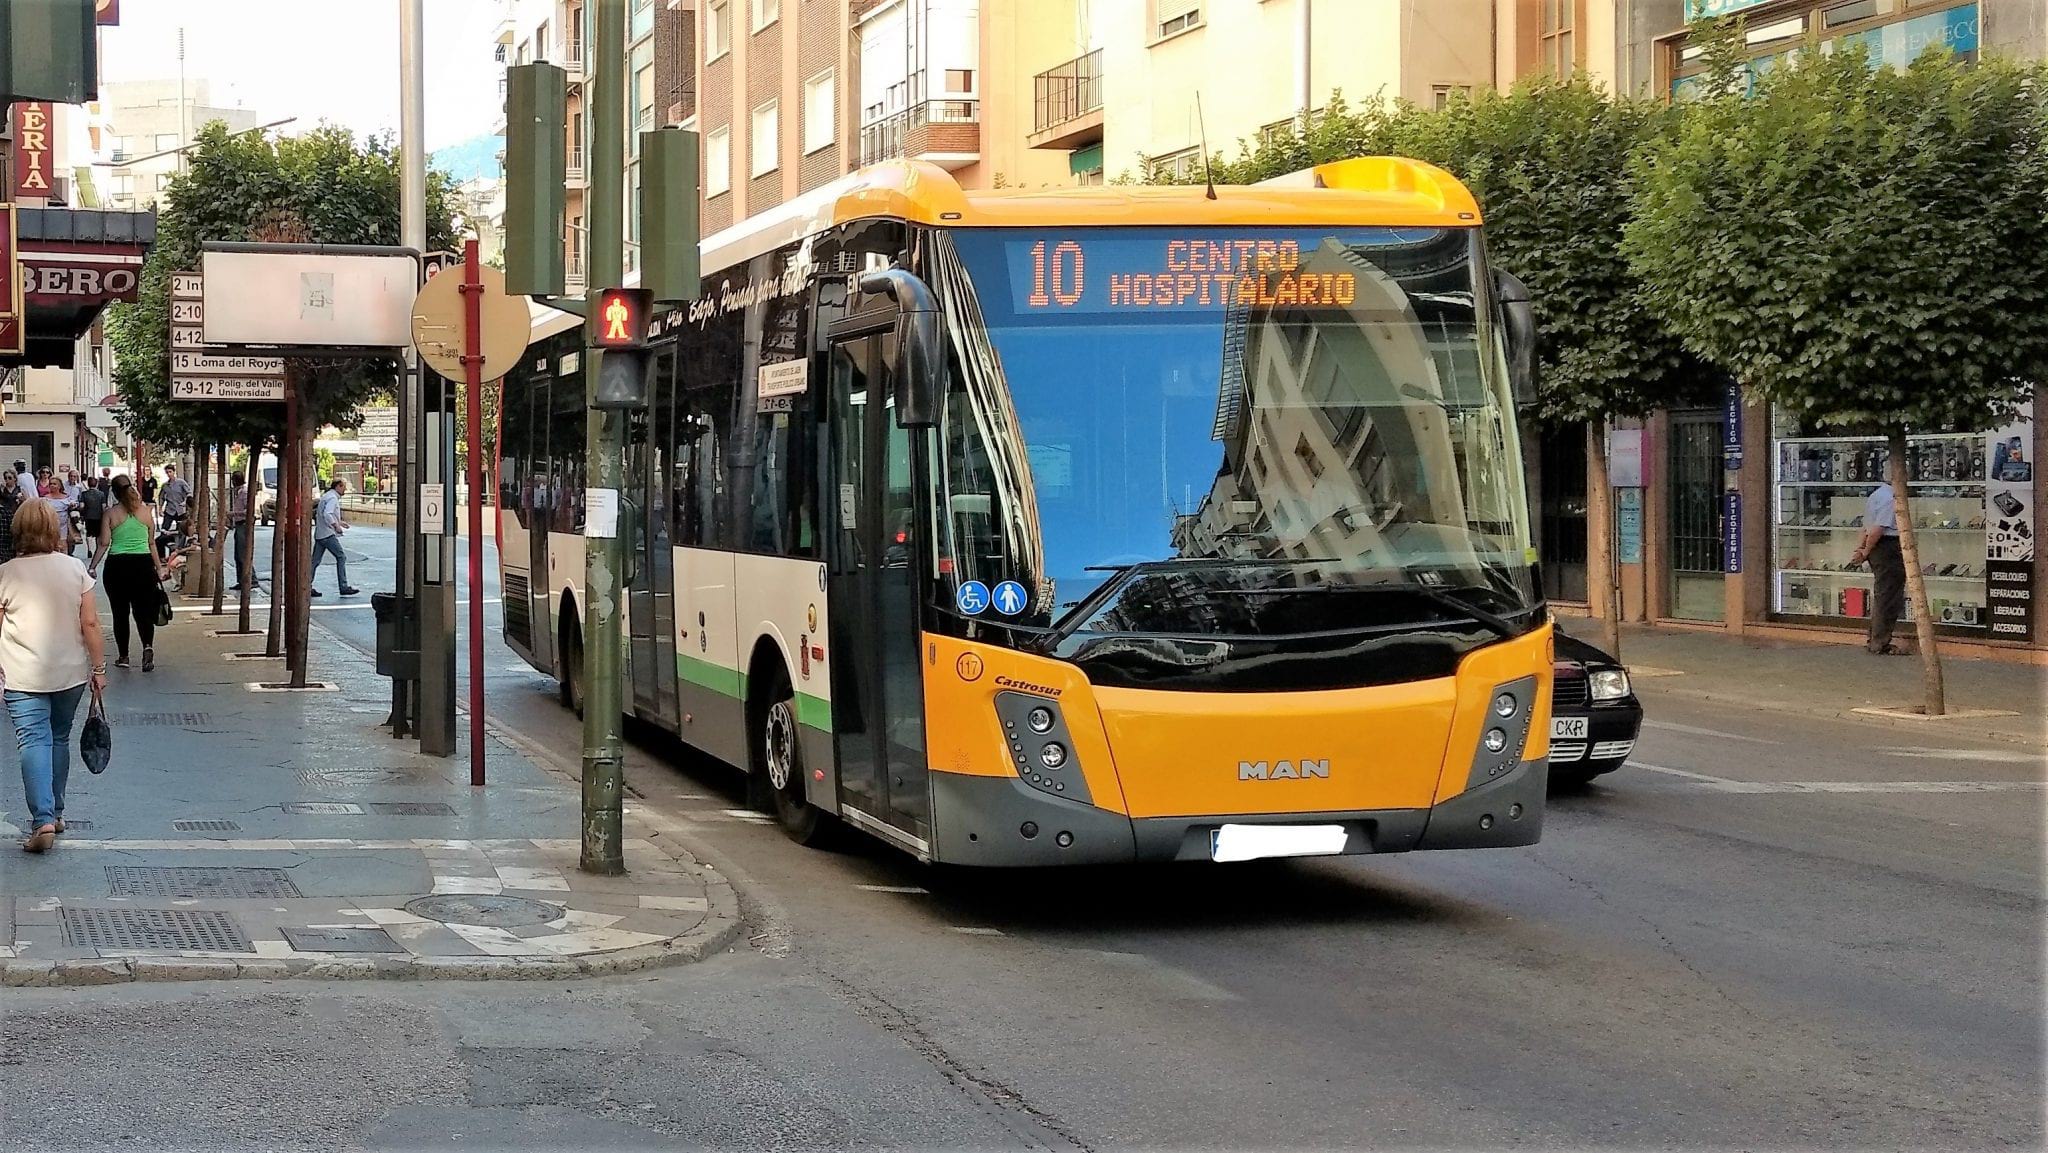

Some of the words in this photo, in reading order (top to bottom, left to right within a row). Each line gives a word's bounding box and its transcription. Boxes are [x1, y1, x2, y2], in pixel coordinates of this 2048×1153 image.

[1167, 239, 1299, 272] CENTRO
[1028, 240, 1084, 307] 10
[174, 278, 181, 291] 2
[755, 276, 780, 315] para
[174, 305, 201, 319] 2-10
[174, 331, 202, 344] 4-12
[174, 355, 189, 368] 15
[194, 358, 225, 367] Loma
[228, 358, 245, 367] del
[174, 381, 213, 394] 7-9-12
[246, 380, 260, 388] del
[261, 380, 283, 388] Valle
[218, 389, 271, 397] Universidad
[1730, 496, 1738, 571] PSICOTECNICO
[1991, 571, 2028, 582] DESBLOQUEO
[1989, 588, 2031, 600] REPARACIONES
[1992, 622, 2028, 634] ACCESORIOS
[959, 659, 978, 675] 117
[994, 675, 1063, 696] Castrosua
[1555, 720, 1585, 737] CKR
[1238, 759, 1330, 781] MAN
